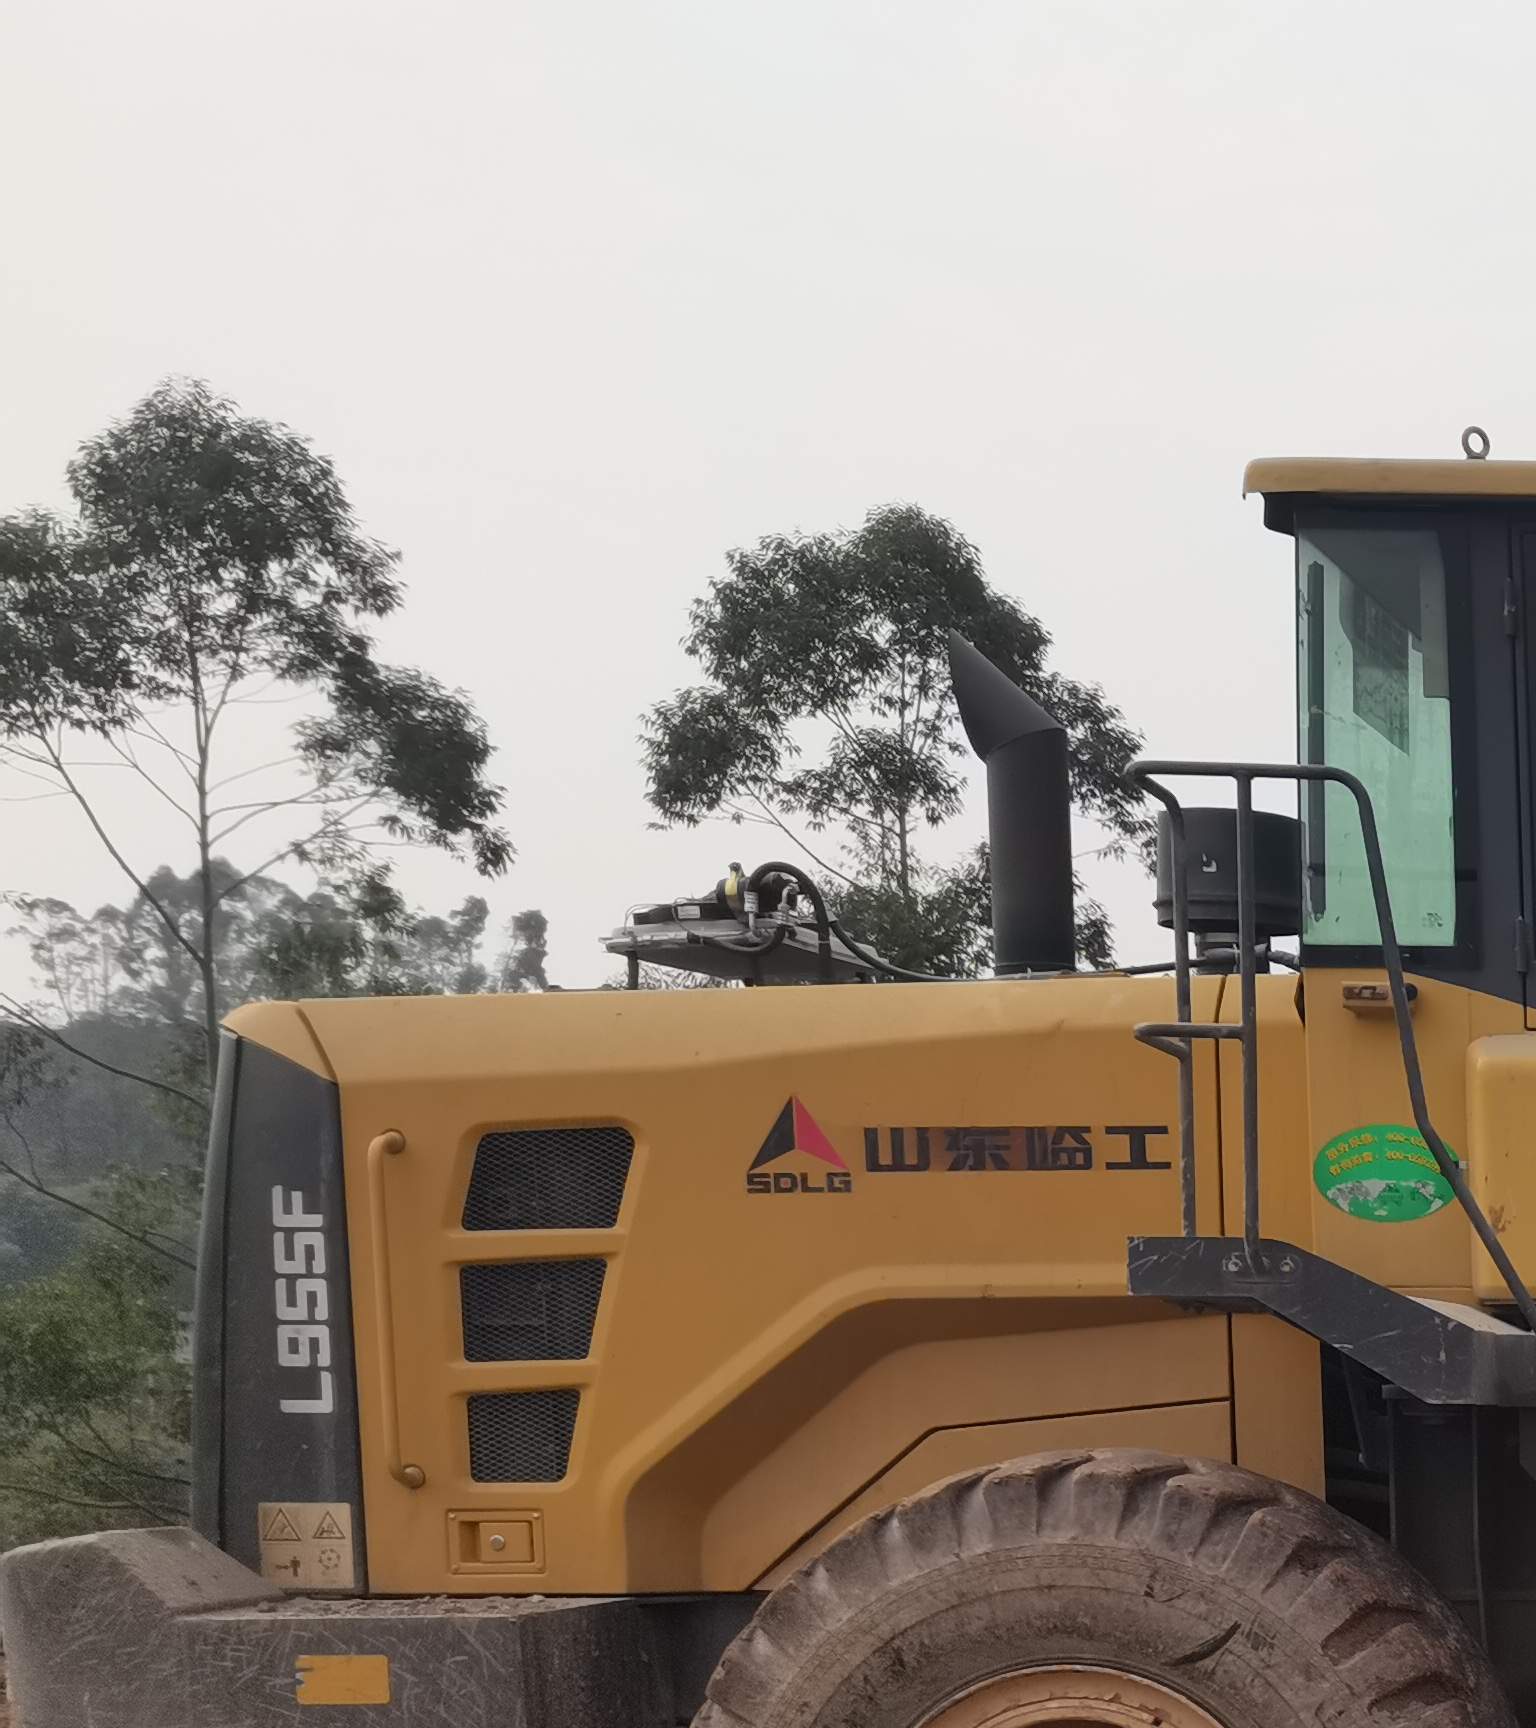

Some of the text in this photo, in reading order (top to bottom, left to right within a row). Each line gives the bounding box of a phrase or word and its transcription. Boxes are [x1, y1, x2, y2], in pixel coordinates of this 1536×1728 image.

[863, 1125, 1172, 1172] 山东临工
[747, 1172, 852, 1193] SDLG
[271, 1184, 334, 1414] L955F
